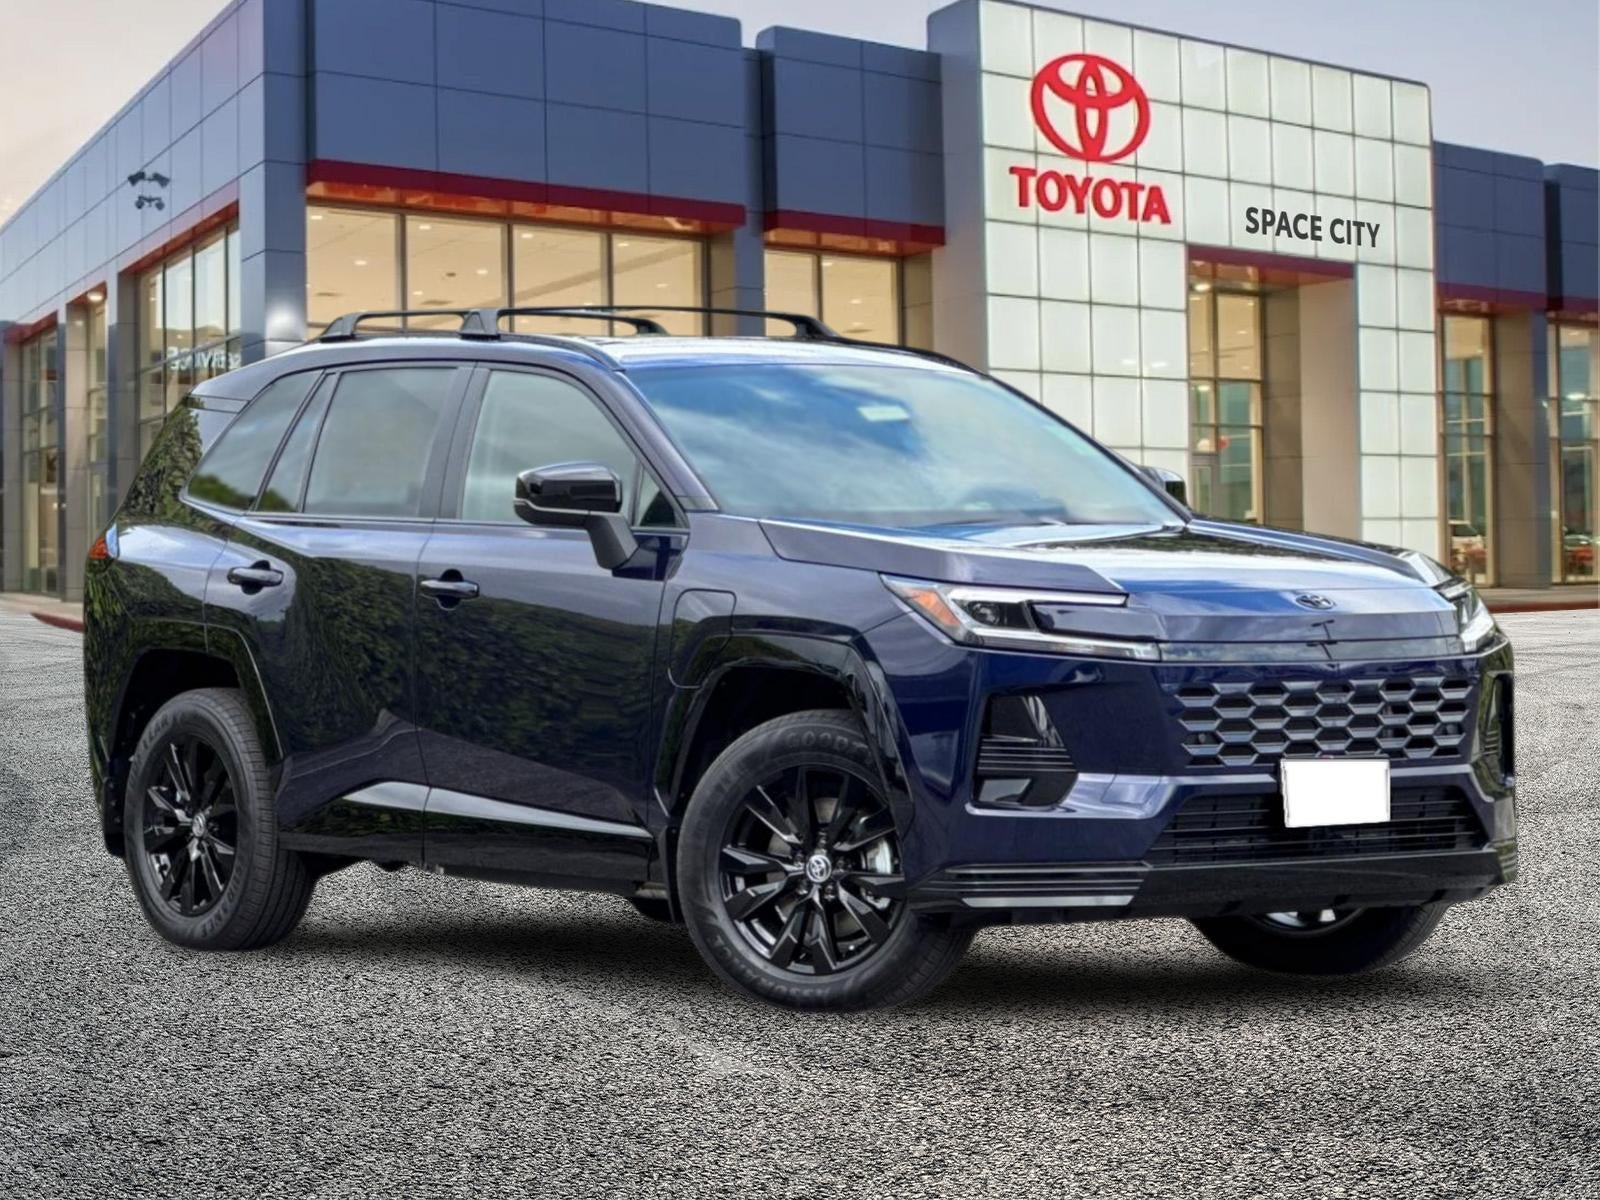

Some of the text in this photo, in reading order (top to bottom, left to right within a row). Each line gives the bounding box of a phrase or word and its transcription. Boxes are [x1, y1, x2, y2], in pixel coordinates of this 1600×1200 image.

[1009, 166, 1172, 225] TOYOTA
[1245, 206, 1381, 248] SPACE CITY
